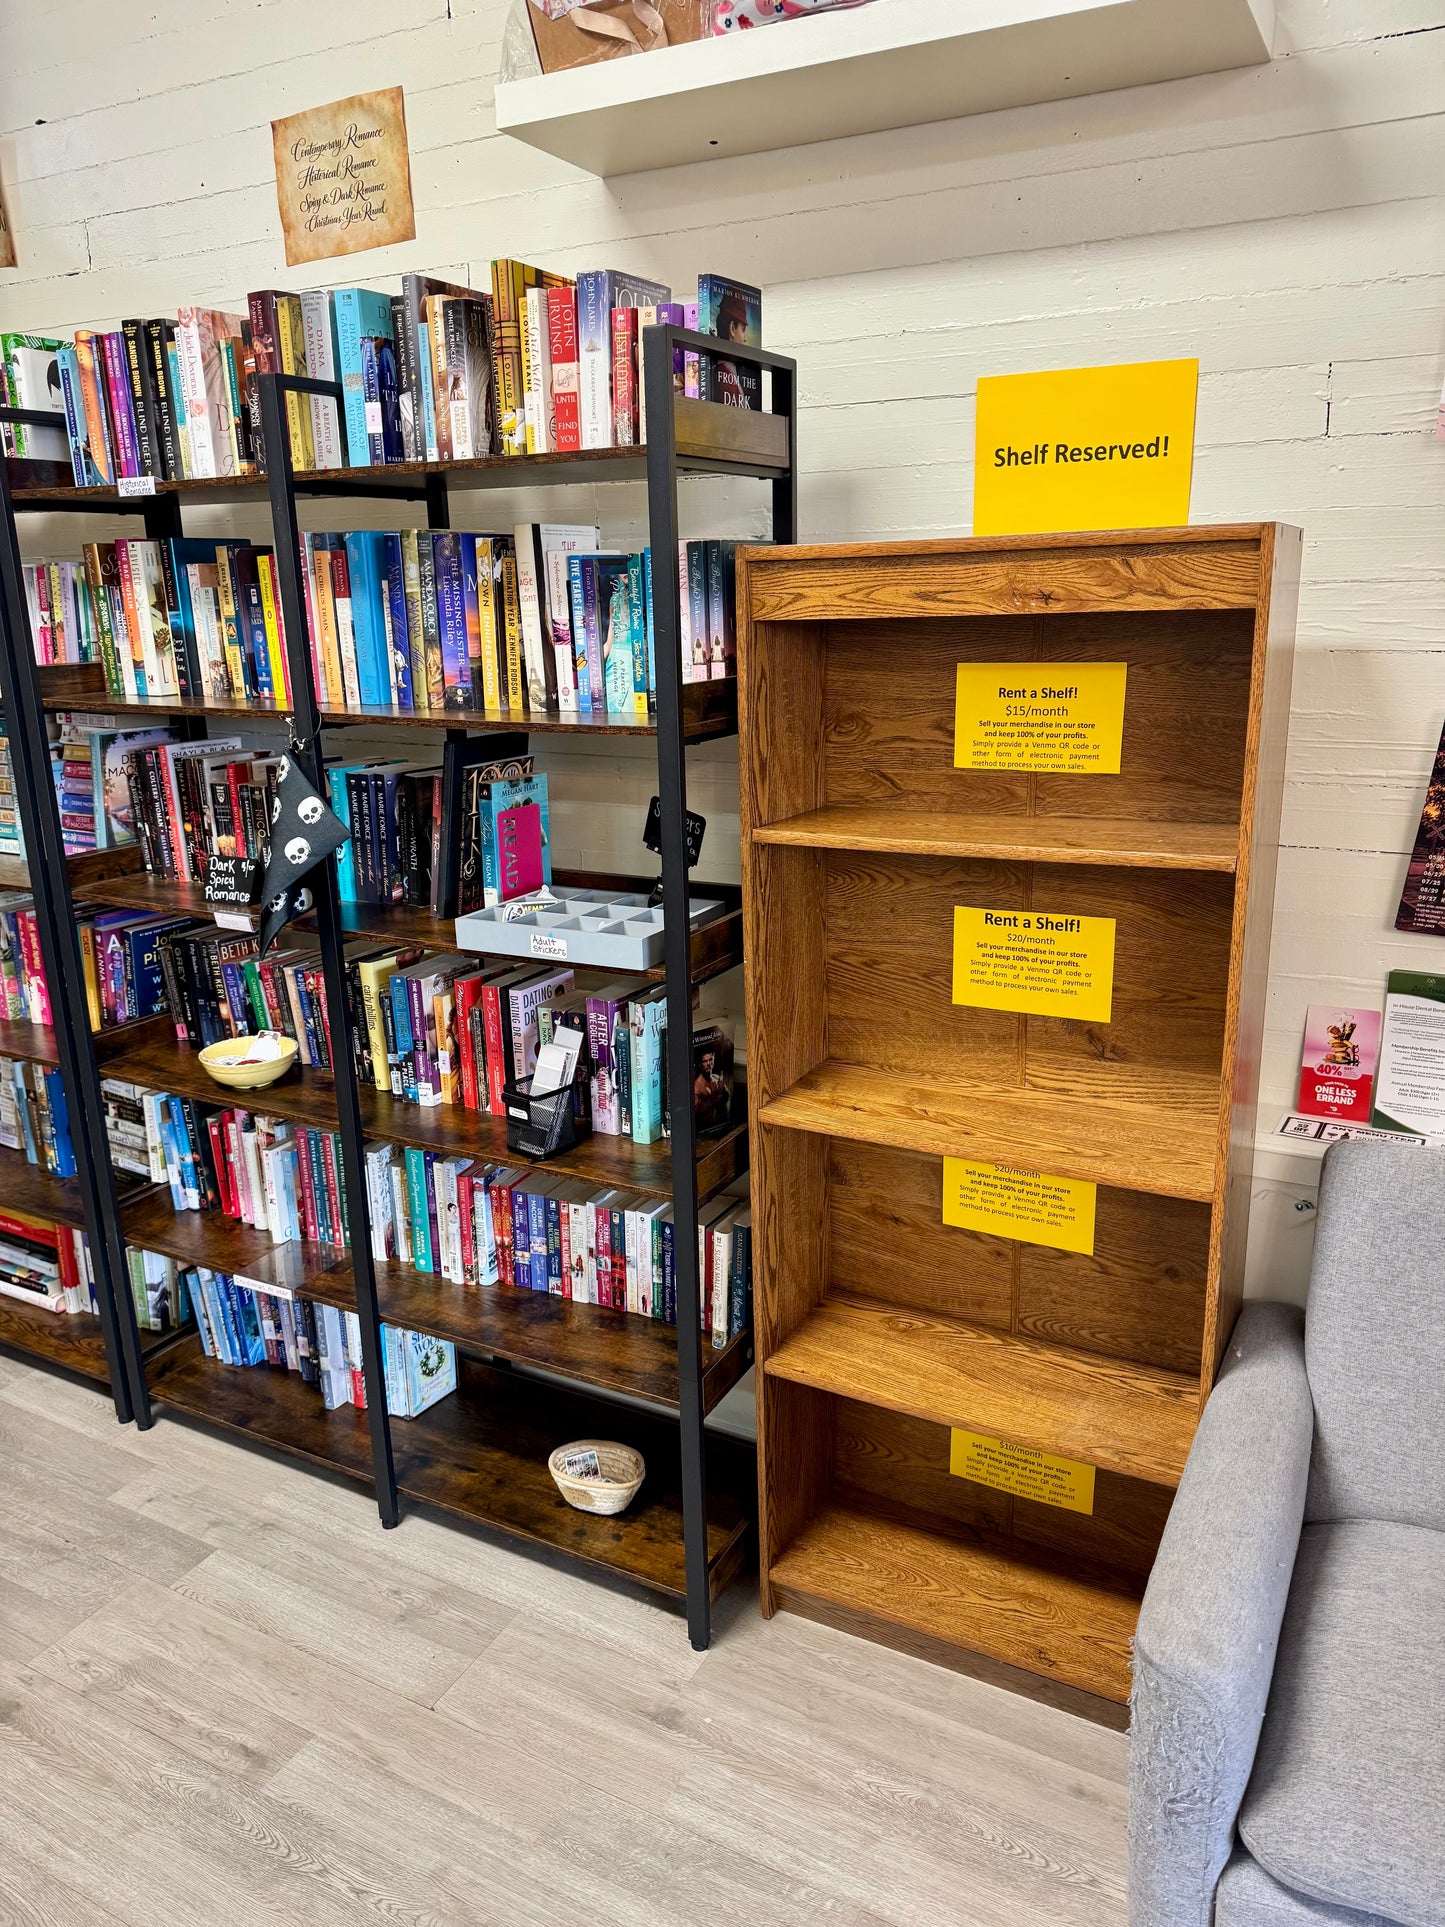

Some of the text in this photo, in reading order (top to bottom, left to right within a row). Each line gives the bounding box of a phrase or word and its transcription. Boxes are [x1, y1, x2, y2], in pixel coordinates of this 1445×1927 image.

[291, 123, 385, 162] Contemporary Romance
[297, 154, 379, 189] Historical Romance
[300, 180, 387, 214] Spicy & Dark Romance
[305, 200, 387, 232] Christmas Year Round
[550, 298, 574, 355] JOHN IRVING
[128, 341, 142, 397] SANDRA BROWN
[154, 341, 167, 398] SANDRA BROWN
[718, 372, 756, 389] FROM THE
[724, 392, 751, 410] DARK
[137, 401, 152, 468] BLIND TIGER
[161, 402, 175, 468] BLIND TIGER
[560, 435, 576, 443] YOU
[994, 435, 1169, 467] Shelf Reserved!
[120, 480, 149, 489] Historical
[505, 562, 513, 606] CORONATION
[443, 576, 455, 647] Lucinda Riley
[453, 580, 462, 627] MISSING
[456, 630, 465, 665] SISTER
[998, 686, 1077, 698] Rent a Shelf!
[1005, 704, 1068, 717] $15/month
[998, 730, 1015, 738] keep
[972, 739, 994, 748] Simply
[1058, 741, 1069, 749] QR
[503, 817, 519, 888] READ
[210, 872, 234, 889] Spicy
[205, 886, 250, 902] Romance
[984, 912, 1080, 932] Rent a Shelf!
[533, 934, 556, 945] Adult
[1007, 933, 1055, 945] $20/month
[994, 952, 1010, 961] keep
[1004, 946, 1046, 954] merchandise
[970, 959, 991, 968] Simply
[1026, 966, 1050, 974] Venmo
[1024, 974, 1056, 984] electronic
[1062, 979, 1091, 987] payment
[590, 1013, 599, 1059] WE COLLIDED
[598, 1013, 608, 1046] AFTER
[1317, 1064, 1342, 1077] 40%
[1315, 1085, 1357, 1098] ONE LESS
[1316, 1094, 1353, 1105] ERRAND
[992, 1175, 1032, 1187] merchandise
[994, 1165, 1040, 1179] $20/month
[982, 1180, 998, 1189] keep
[999, 1184, 1016, 1192] 100%
[1041, 1193, 1064, 1201] profits.
[999, 1441, 1043, 1459] $10/month
